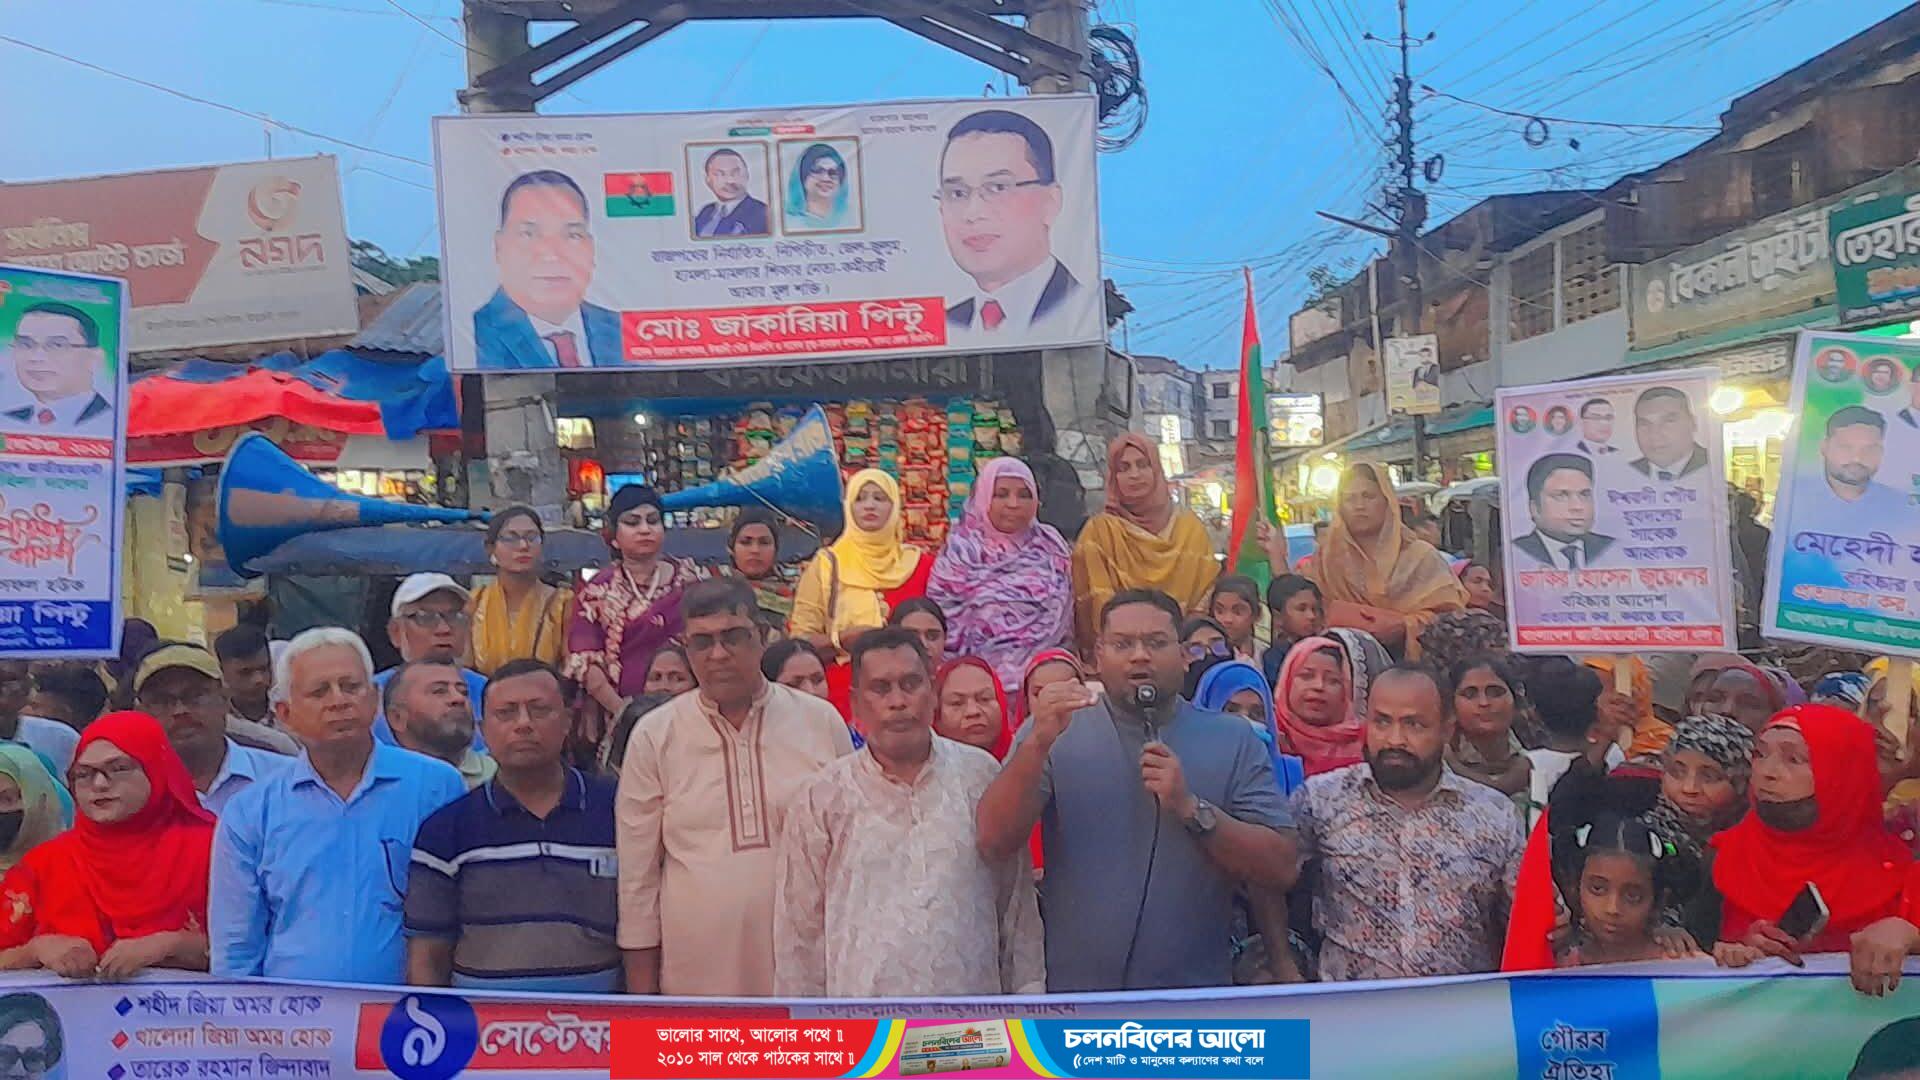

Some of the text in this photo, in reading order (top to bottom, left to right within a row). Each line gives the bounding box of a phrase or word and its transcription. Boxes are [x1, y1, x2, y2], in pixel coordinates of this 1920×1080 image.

[239, 234, 325, 269] নগদ
[637, 301, 926, 342] মোঃ জাকারিয়া পিন্টু
[1794, 530, 1900, 566] মেহেদী
[32, 601, 93, 629] পিন্টু
[136, 989, 323, 1016] শহীদ জিয়া অমর হোক
[201, 1020, 240, 1047] জিয়া
[243, 1027, 286, 1047] অমর
[289, 1027, 333, 1048] হোক
[402, 996, 610, 1067] ৯ সেপ্টেম্ব
[1540, 1023, 1610, 1052] গৌরব
[130, 1051, 331, 1079] তারেক রহমান জিন্দাবাদ
